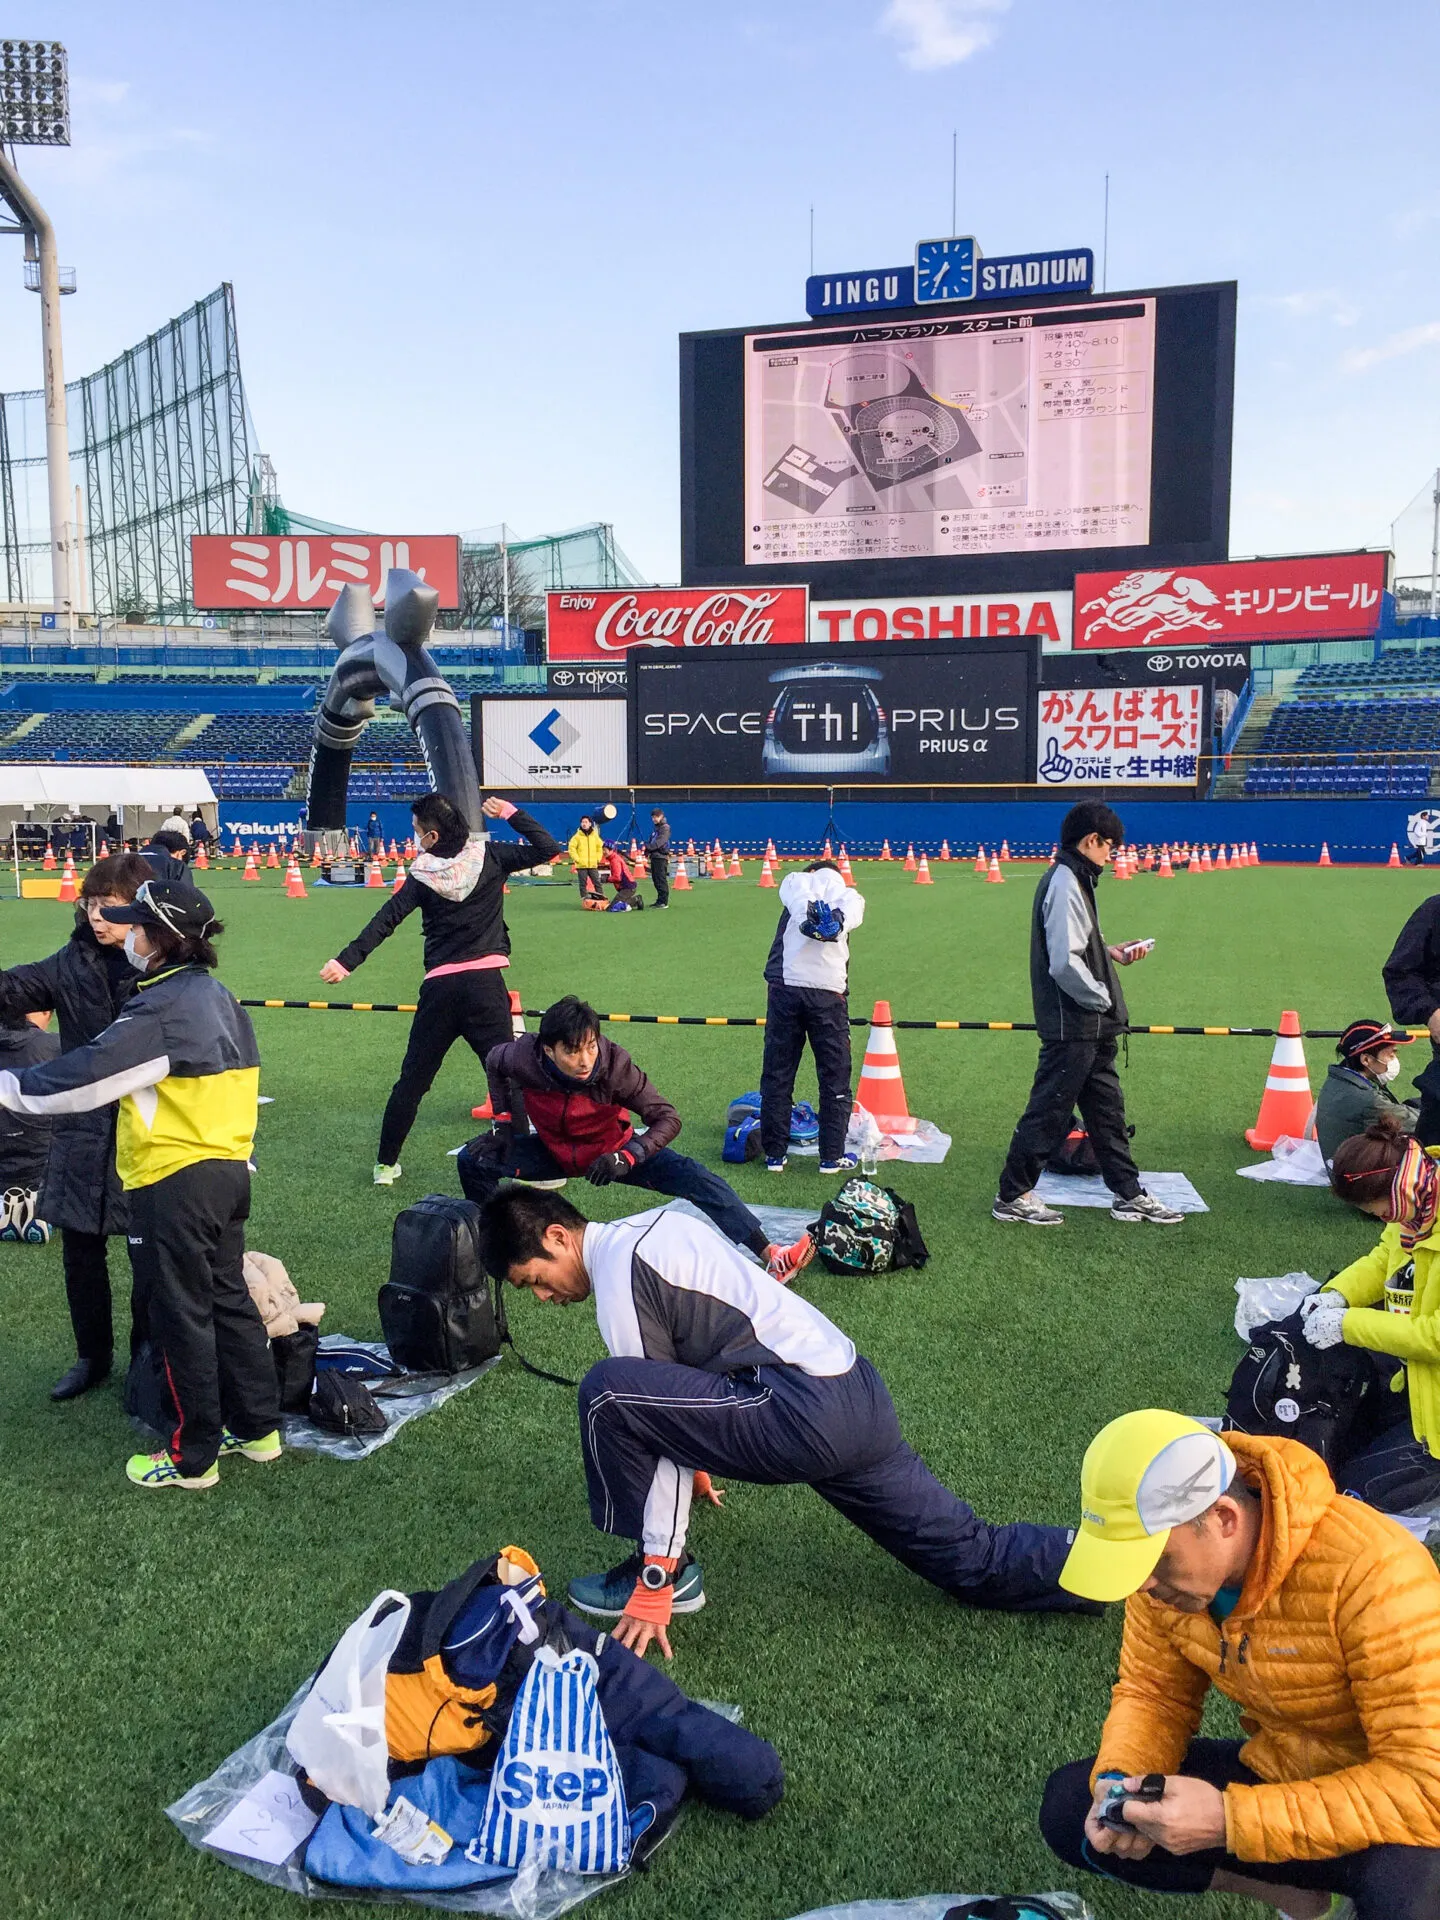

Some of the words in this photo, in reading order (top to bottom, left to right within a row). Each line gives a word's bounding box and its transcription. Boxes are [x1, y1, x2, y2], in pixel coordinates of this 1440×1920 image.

[822, 277, 899, 307] JINGU
[983, 256, 1087, 289] STADIUM
[853, 324, 949, 343] ハーフマラソン
[962, 316, 1033, 333] スタート前
[560, 594, 597, 610] Enjoy
[1225, 583, 1378, 616] キリンビール
[595, 592, 782, 651] Coca-Cola
[818, 602, 1061, 643] TOSHIBA
[1176, 653, 1247, 669] TOYOTA
[1041, 687, 1199, 724] がんばれ!
[645, 712, 761, 735] SPACE
[793, 702, 859, 742] デカ!
[892, 707, 1019, 732] PRIUS
[920, 739, 969, 753] PRIUS
[1062, 722, 1198, 751] スワローズ!
[528, 765, 583, 774] SPORT
[1074, 756, 1112, 764] フジテレビ
[543, 1801, 570, 1811] JAPAN
